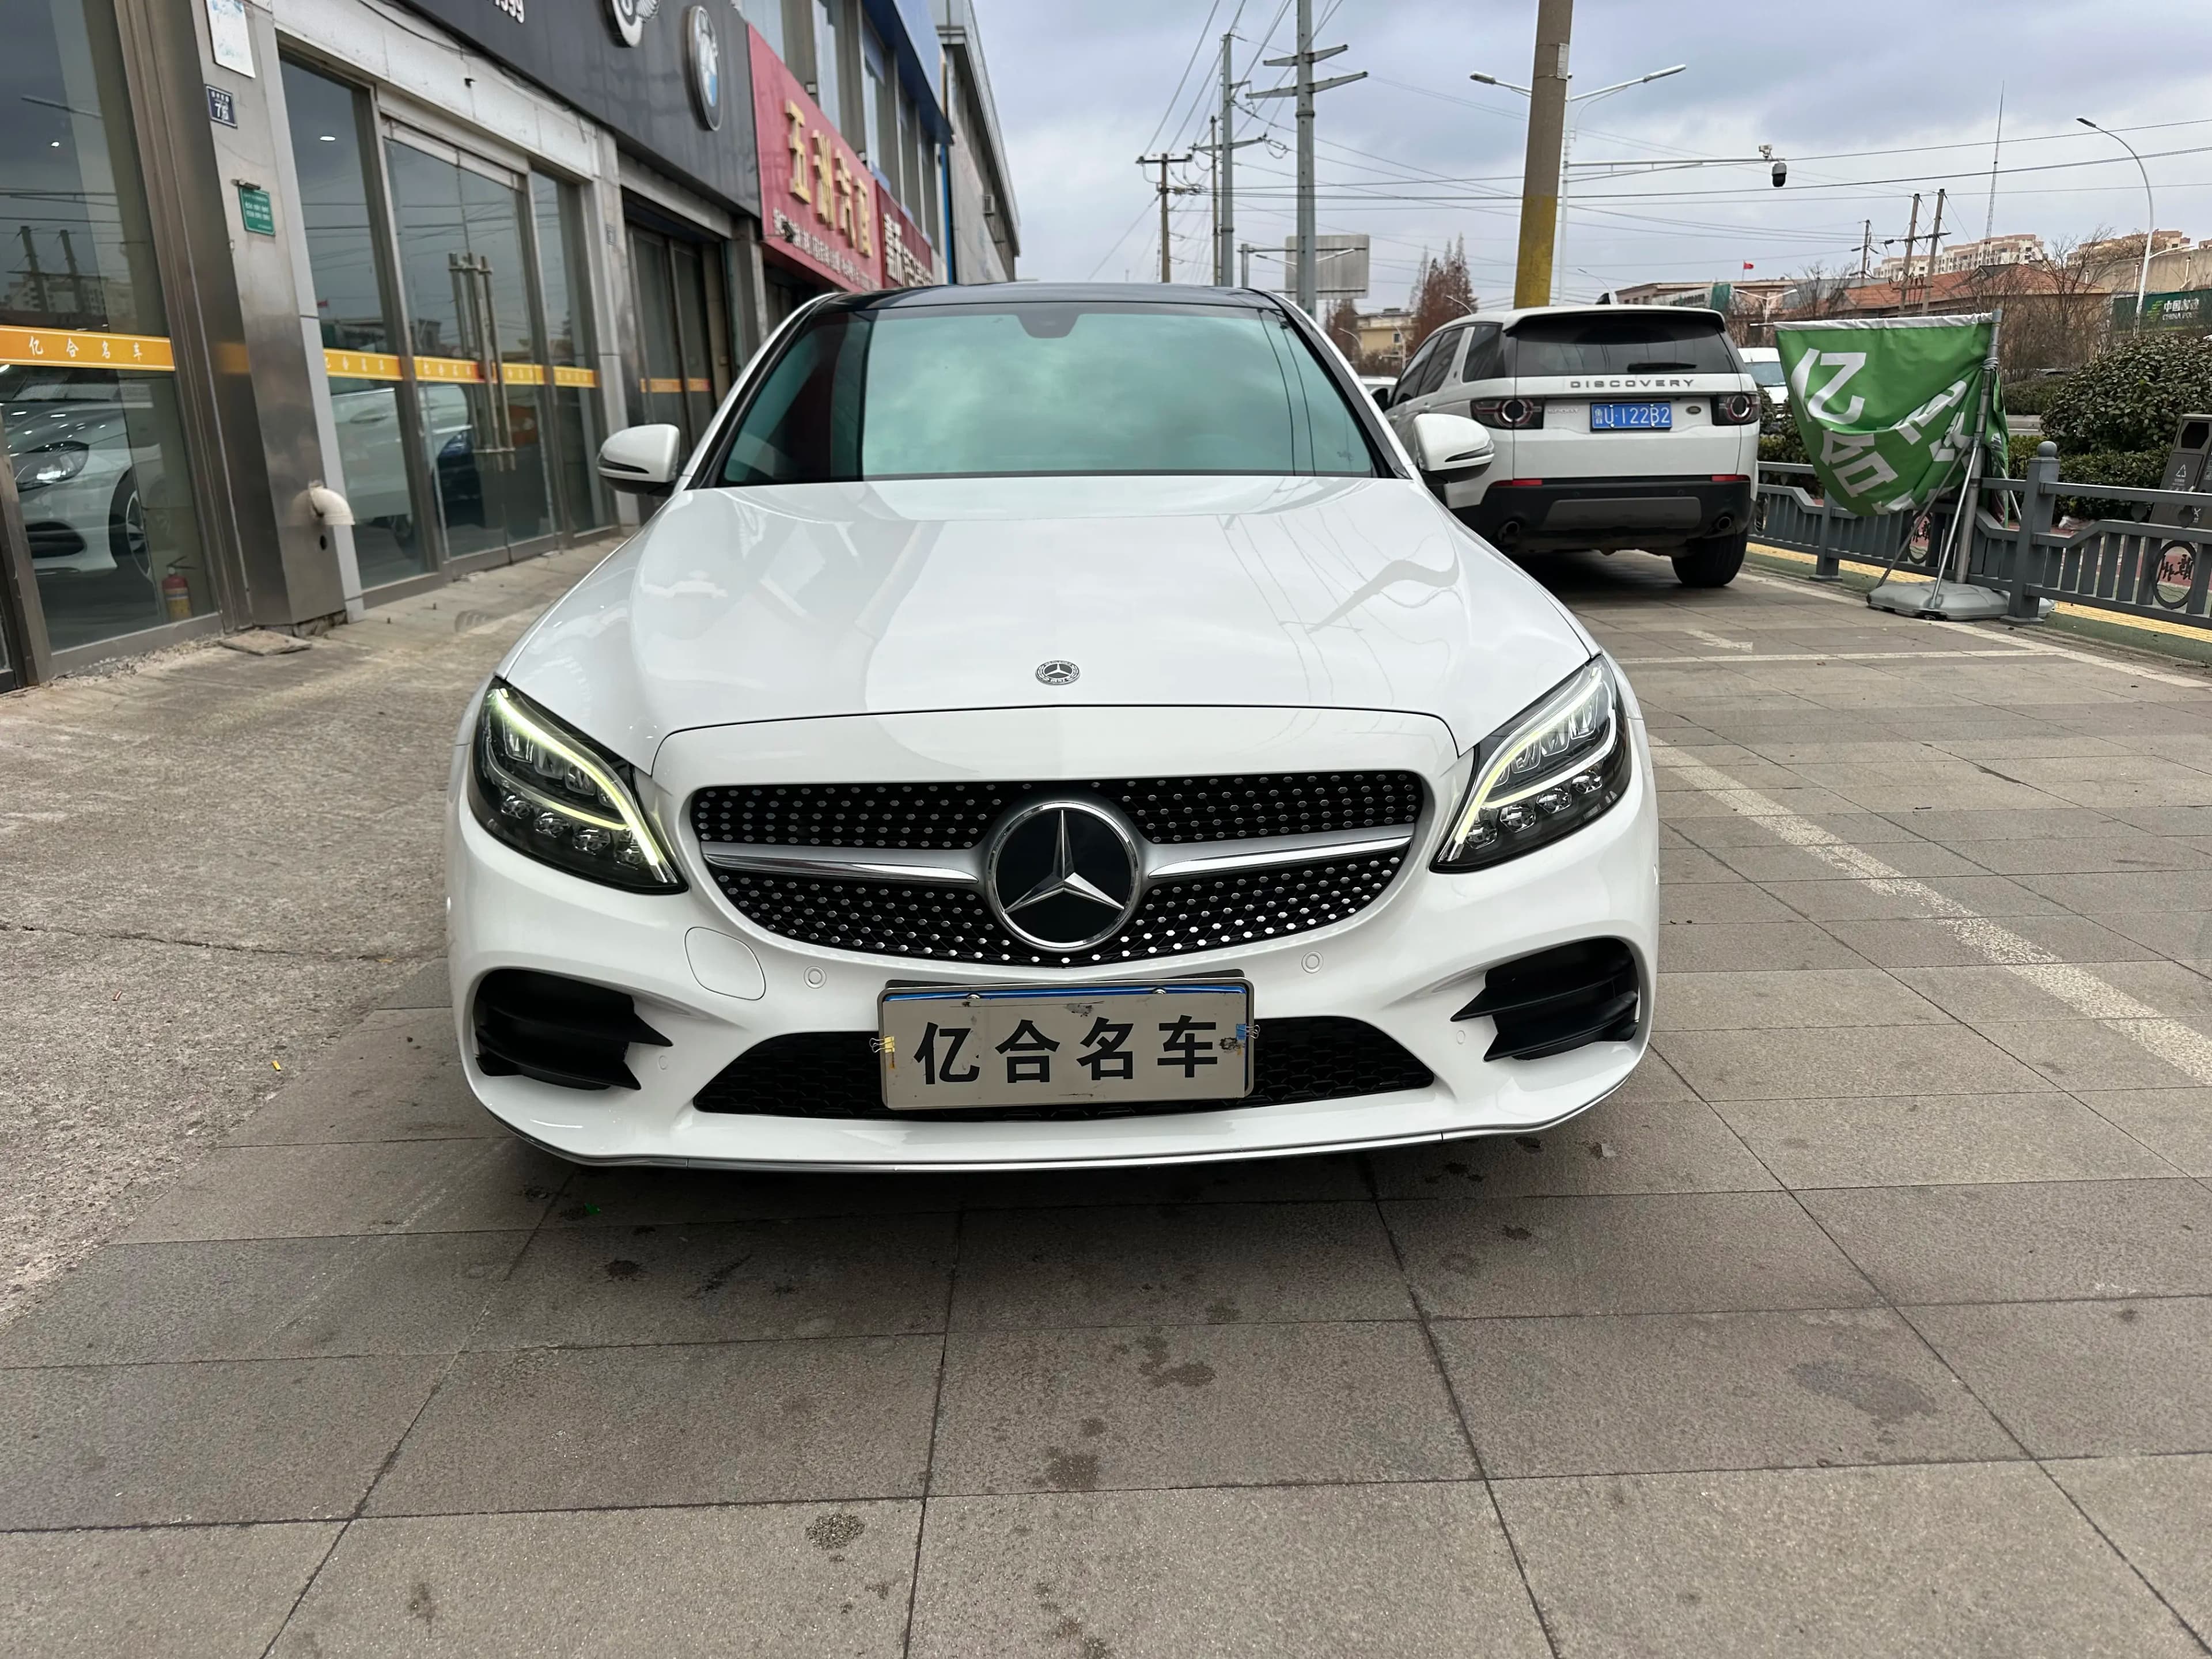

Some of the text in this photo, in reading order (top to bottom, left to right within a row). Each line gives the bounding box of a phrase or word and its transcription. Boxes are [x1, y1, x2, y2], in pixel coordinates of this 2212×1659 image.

[29, 336, 142, 362] 亿合名车
[1570, 379, 1694, 389] DISCOVERY
[914, 1014, 1218, 1085] 亿合名车
